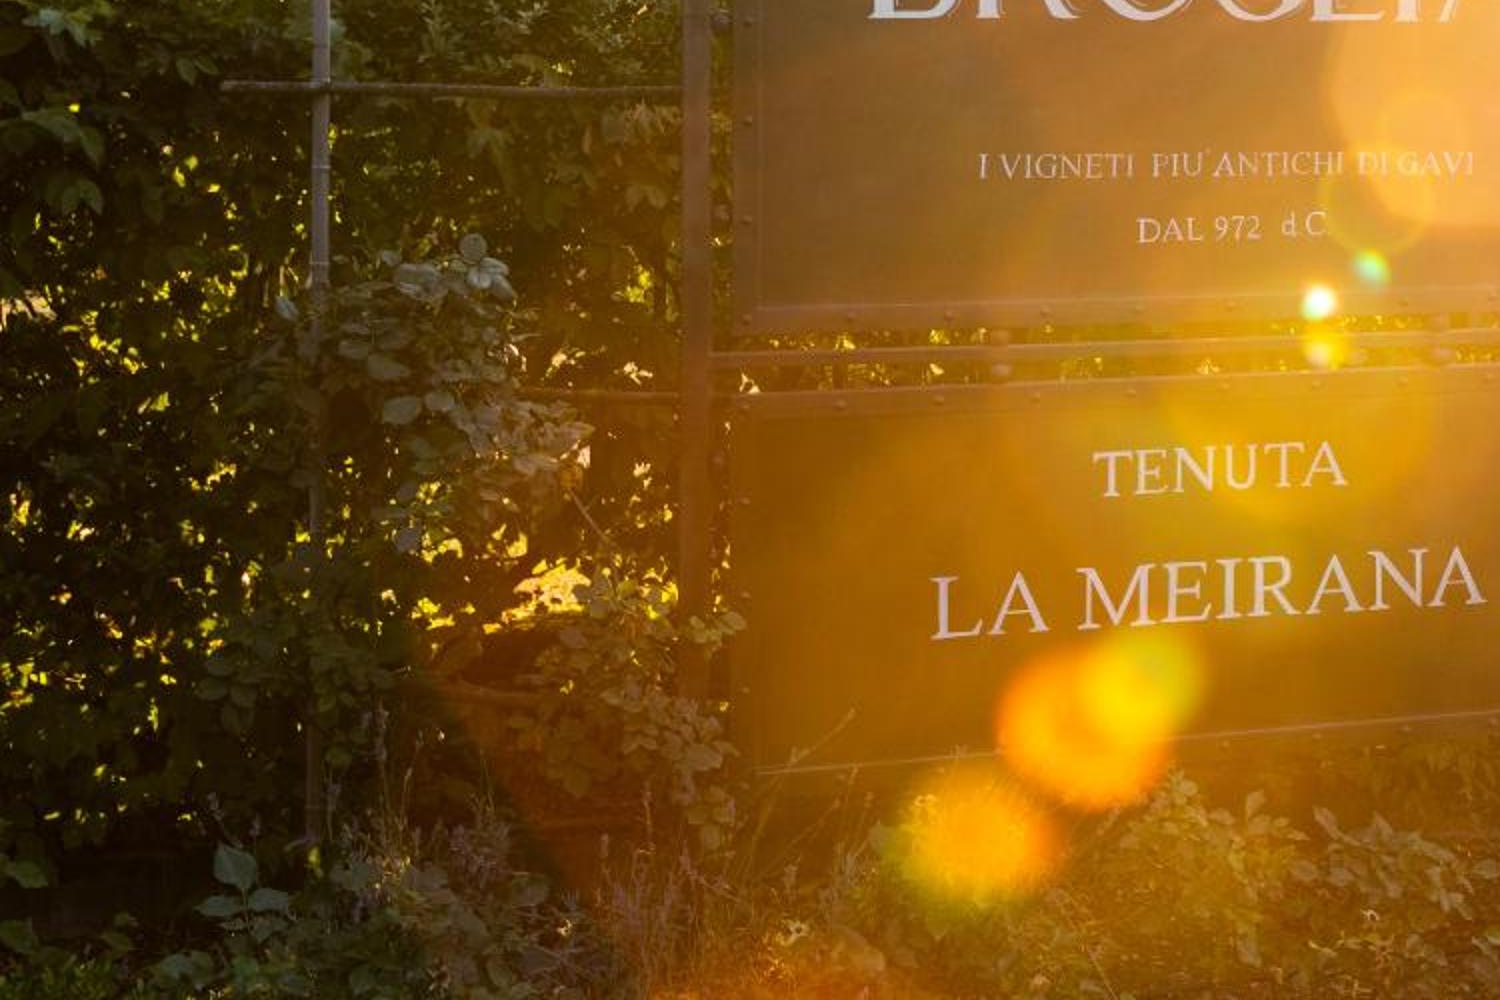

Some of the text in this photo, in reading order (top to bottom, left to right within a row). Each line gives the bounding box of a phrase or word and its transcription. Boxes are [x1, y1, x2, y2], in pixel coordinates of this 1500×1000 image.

[978, 152, 988, 180] I
[1000, 153, 1135, 179] VIGNETI
[1357, 151, 1388, 176] DI
[1397, 151, 1473, 176] GAVI
[1136, 216, 1204, 244] DAL
[1215, 215, 1262, 241] 972
[1092, 441, 1348, 498] TENUTA
[930, 545, 1489, 641] LA MEIRANA
